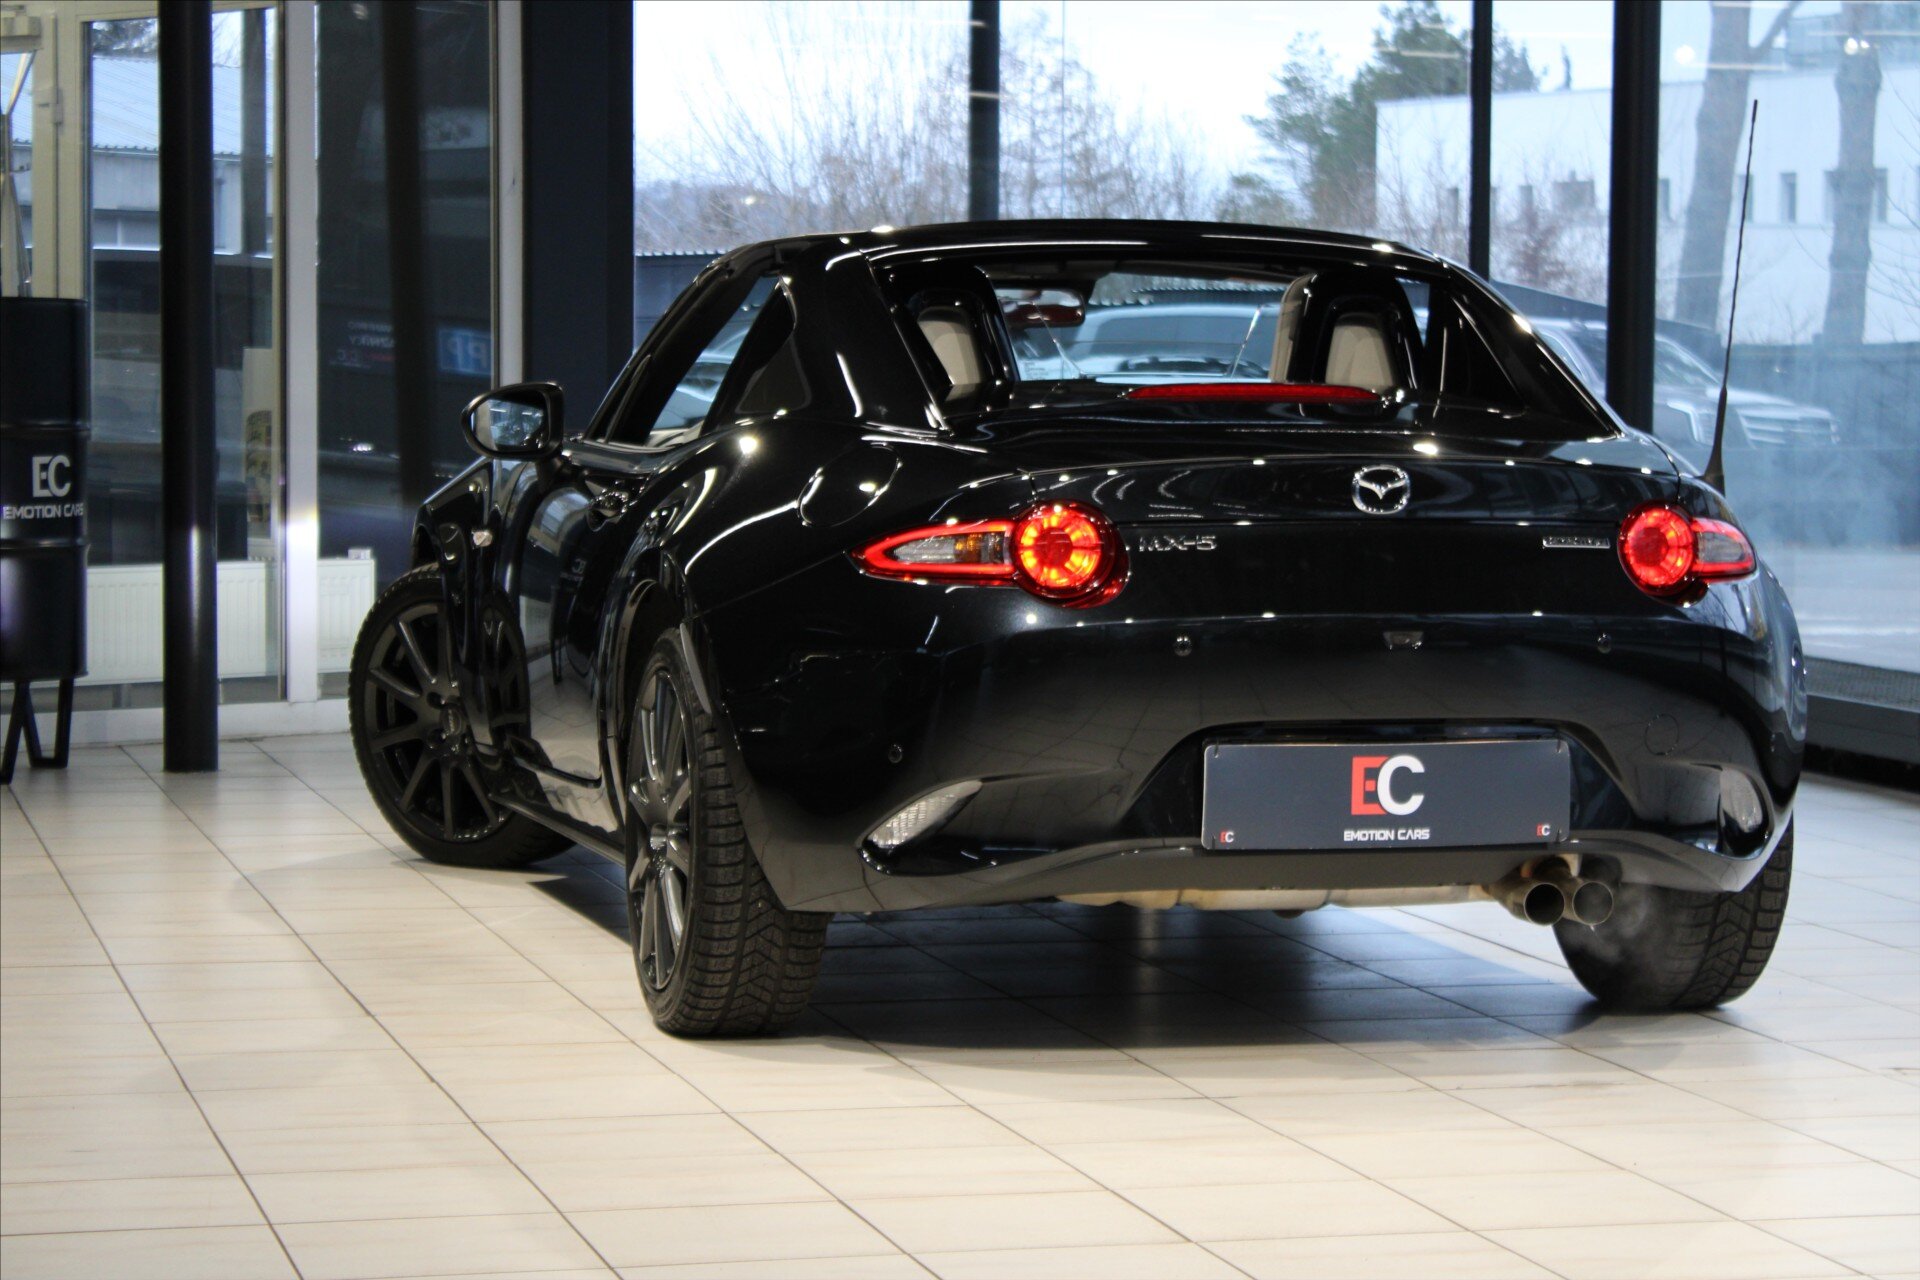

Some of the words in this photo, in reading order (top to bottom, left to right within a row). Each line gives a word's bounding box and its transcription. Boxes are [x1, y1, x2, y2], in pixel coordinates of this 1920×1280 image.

[32, 454, 71, 498] EC
[2, 504, 61, 519] EMOTION
[1350, 754, 1426, 816] EC
[1343, 829, 1395, 842] EMOTION
[1397, 827, 1431, 840] CARS
